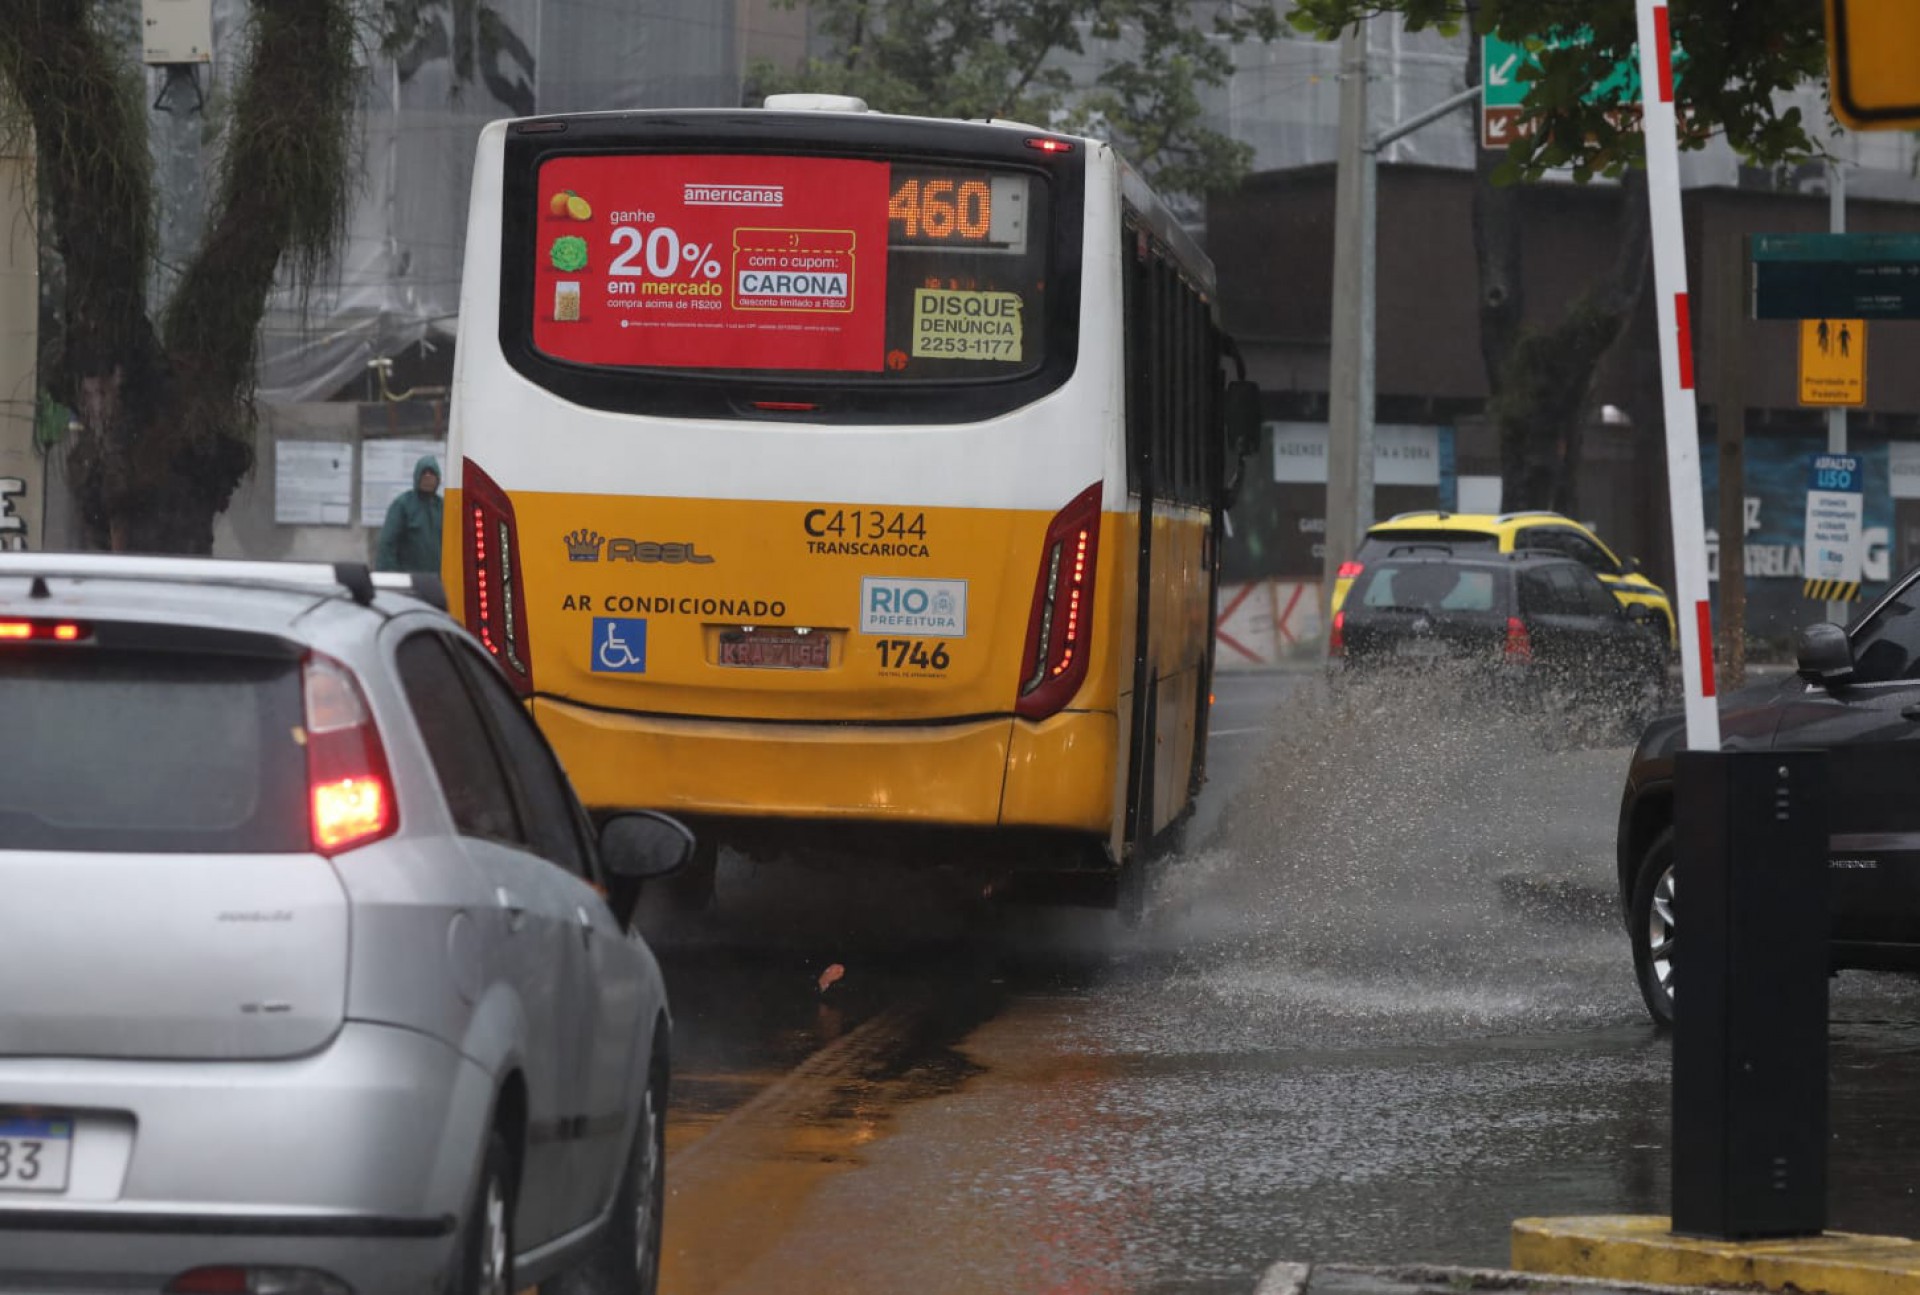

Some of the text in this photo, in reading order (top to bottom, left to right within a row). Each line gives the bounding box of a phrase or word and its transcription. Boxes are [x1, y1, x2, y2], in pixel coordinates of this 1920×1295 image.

[684, 188, 783, 203] americanas
[610, 209, 655, 224] ganhe
[889, 179, 990, 238] 460
[609, 226, 721, 278] 20%
[749, 256, 839, 270] com o cupom:
[607, 280, 723, 296] em mercado
[742, 273, 844, 295] CARONA
[607, 299, 722, 310] compra acima de R$200
[739, 297, 779, 307] desconto
[780, 298, 814, 308] limitado
[922, 295, 1016, 317] DISQUE
[921, 317, 1014, 336] DENÚNCIA
[921, 337, 1014, 354] 2253-1177
[1817, 470, 1852, 489] LISO
[804, 508, 927, 541] C41344
[807, 541, 930, 558] TRANSCARIOCA
[562, 595, 786, 618] AR CONDICIONADO
[871, 586, 929, 615] RIO
[870, 614, 956, 628] PREFEITURA
[876, 640, 951, 671] 1746
